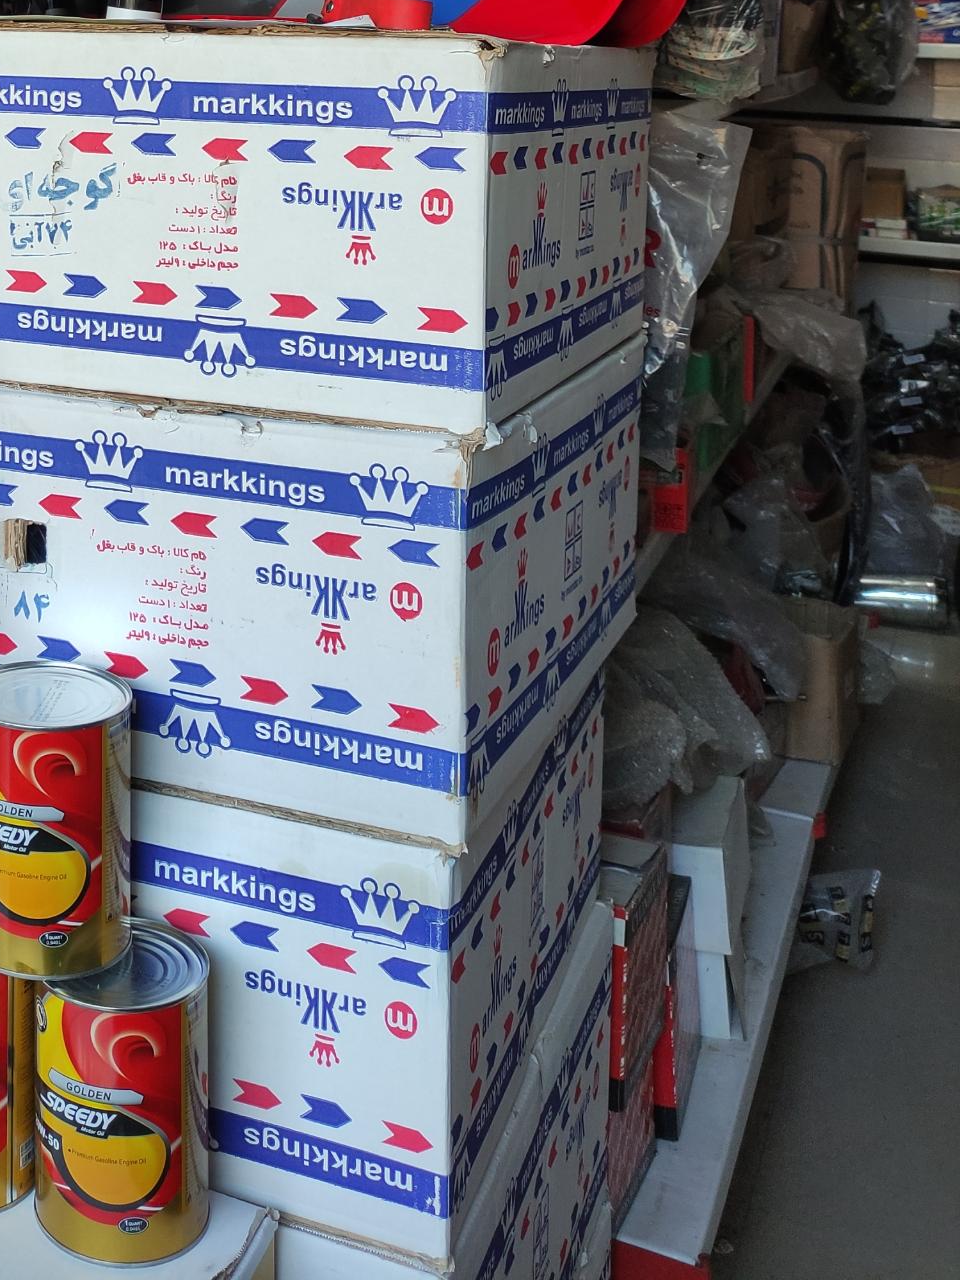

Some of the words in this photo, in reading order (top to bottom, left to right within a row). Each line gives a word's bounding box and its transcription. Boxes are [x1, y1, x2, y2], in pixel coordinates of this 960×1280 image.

[192, 92, 354, 125] markkings
[158, 240, 177, 251] ۱۲۵
[16, 309, 164, 344] markkings
[279, 336, 449, 373] markkings
[164, 464, 326, 505] markkings
[470, 475, 526, 520] markkings
[128, 611, 148, 624] ۱۲۵
[253, 720, 424, 773] markkings
[2, 842, 19, 852] Motor
[18, 845, 28, 853] Oil
[16, 871, 39, 880] Gasoline
[39, 873, 59, 882] Engine
[58, 873, 68, 881] Oil
[153, 857, 317, 914] markkings
[66, 1081, 112, 1102] GOLDEN
[39, 1090, 118, 1131] SPEEDY
[94, 1155, 118, 1165] Gasoline
[118, 1158, 139, 1167] Engine
[138, 1156, 147, 1165] Oil
[243, 1124, 414, 1193] markkings
